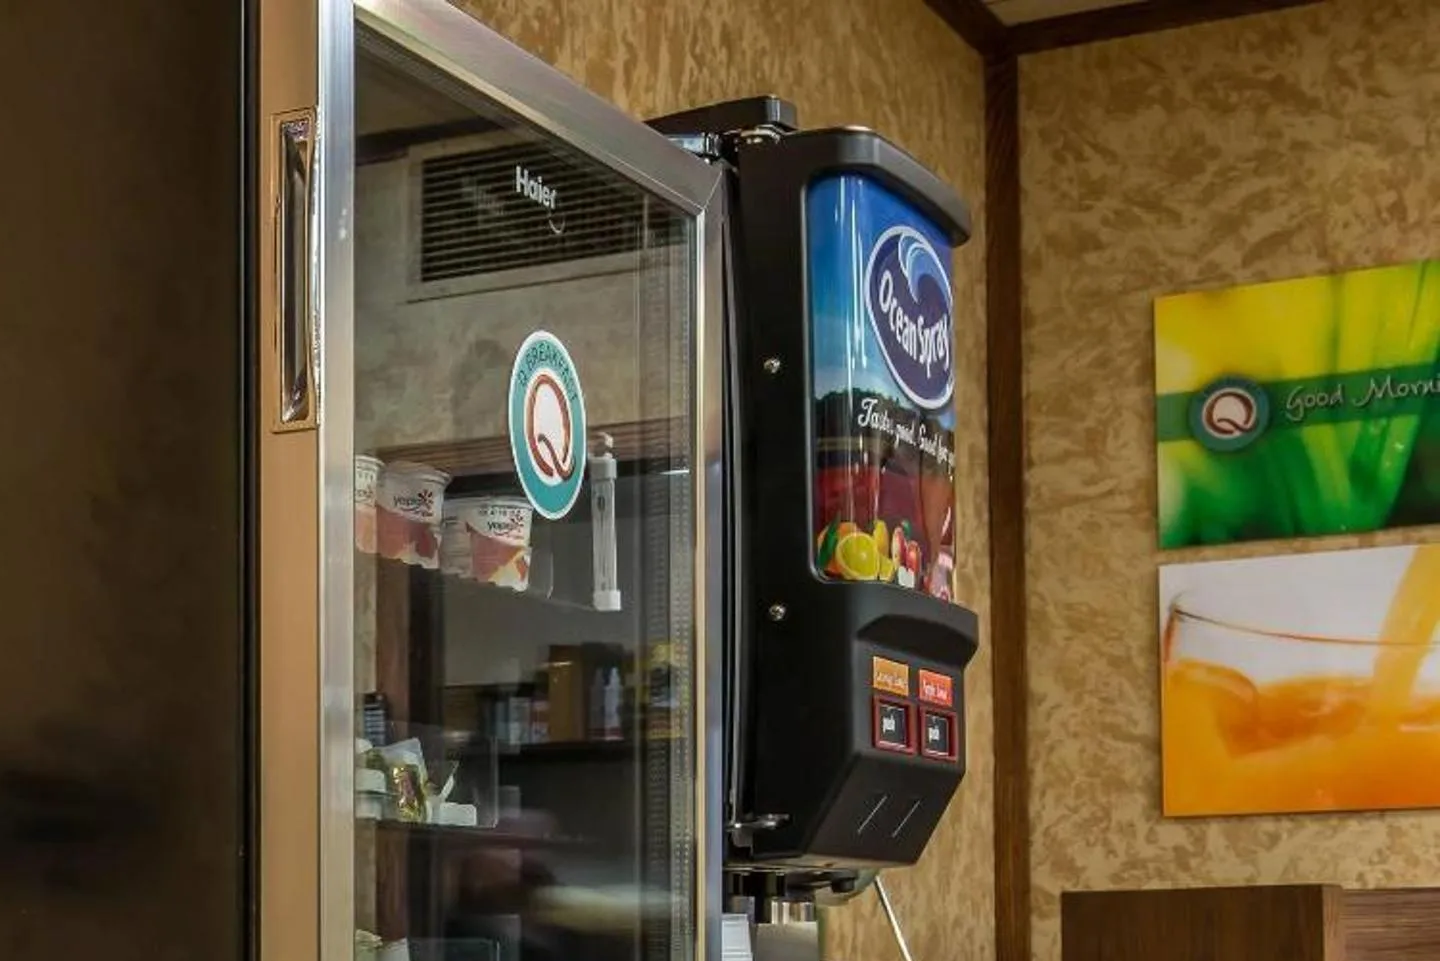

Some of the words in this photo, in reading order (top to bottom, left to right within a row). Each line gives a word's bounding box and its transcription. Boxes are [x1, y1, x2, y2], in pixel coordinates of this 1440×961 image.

[515, 165, 557, 210] Haier
[879, 269, 917, 361] Ocean
[917, 313, 949, 379] Spray
[1205, 390, 1257, 435] Q
[1284, 384, 1344, 422] Good
